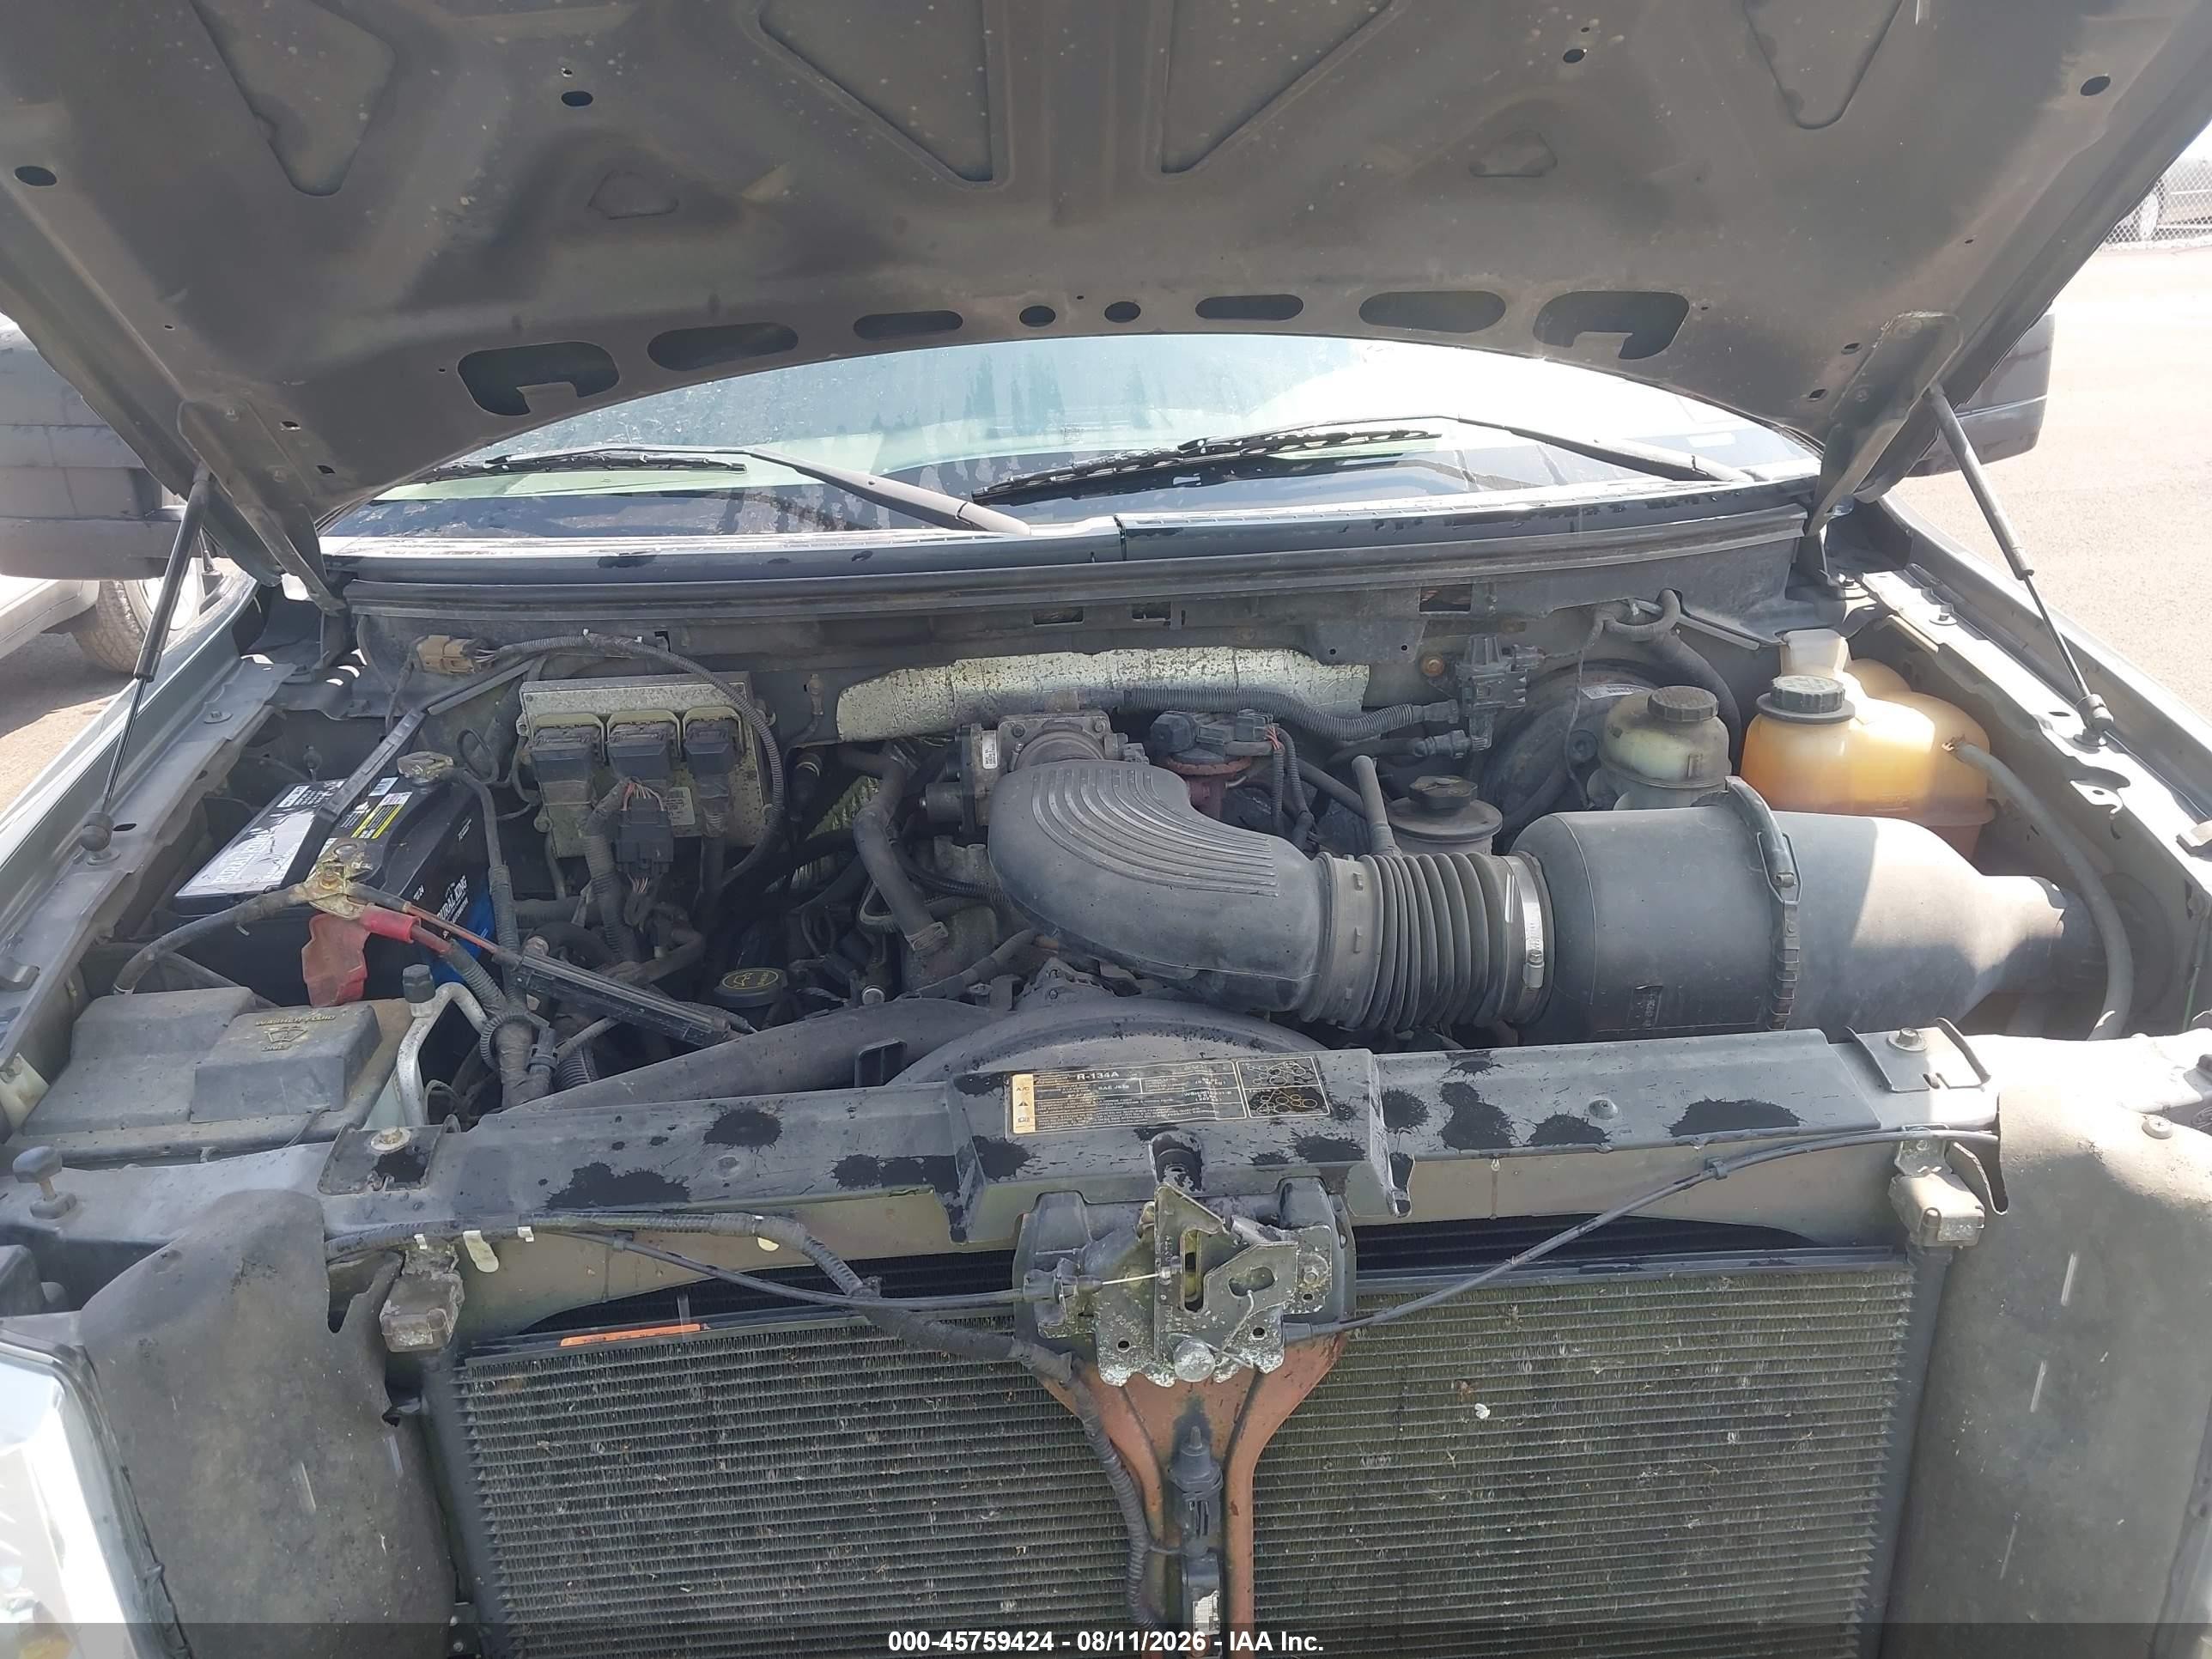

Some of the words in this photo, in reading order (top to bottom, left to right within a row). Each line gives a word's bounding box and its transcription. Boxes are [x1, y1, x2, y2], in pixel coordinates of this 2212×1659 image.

[453, 875, 466, 900] KING
[255, 1016, 302, 1026] WASHER
[305, 1014, 337, 1023] FLUID
[1077, 1071, 1120, 1080] R-134A
